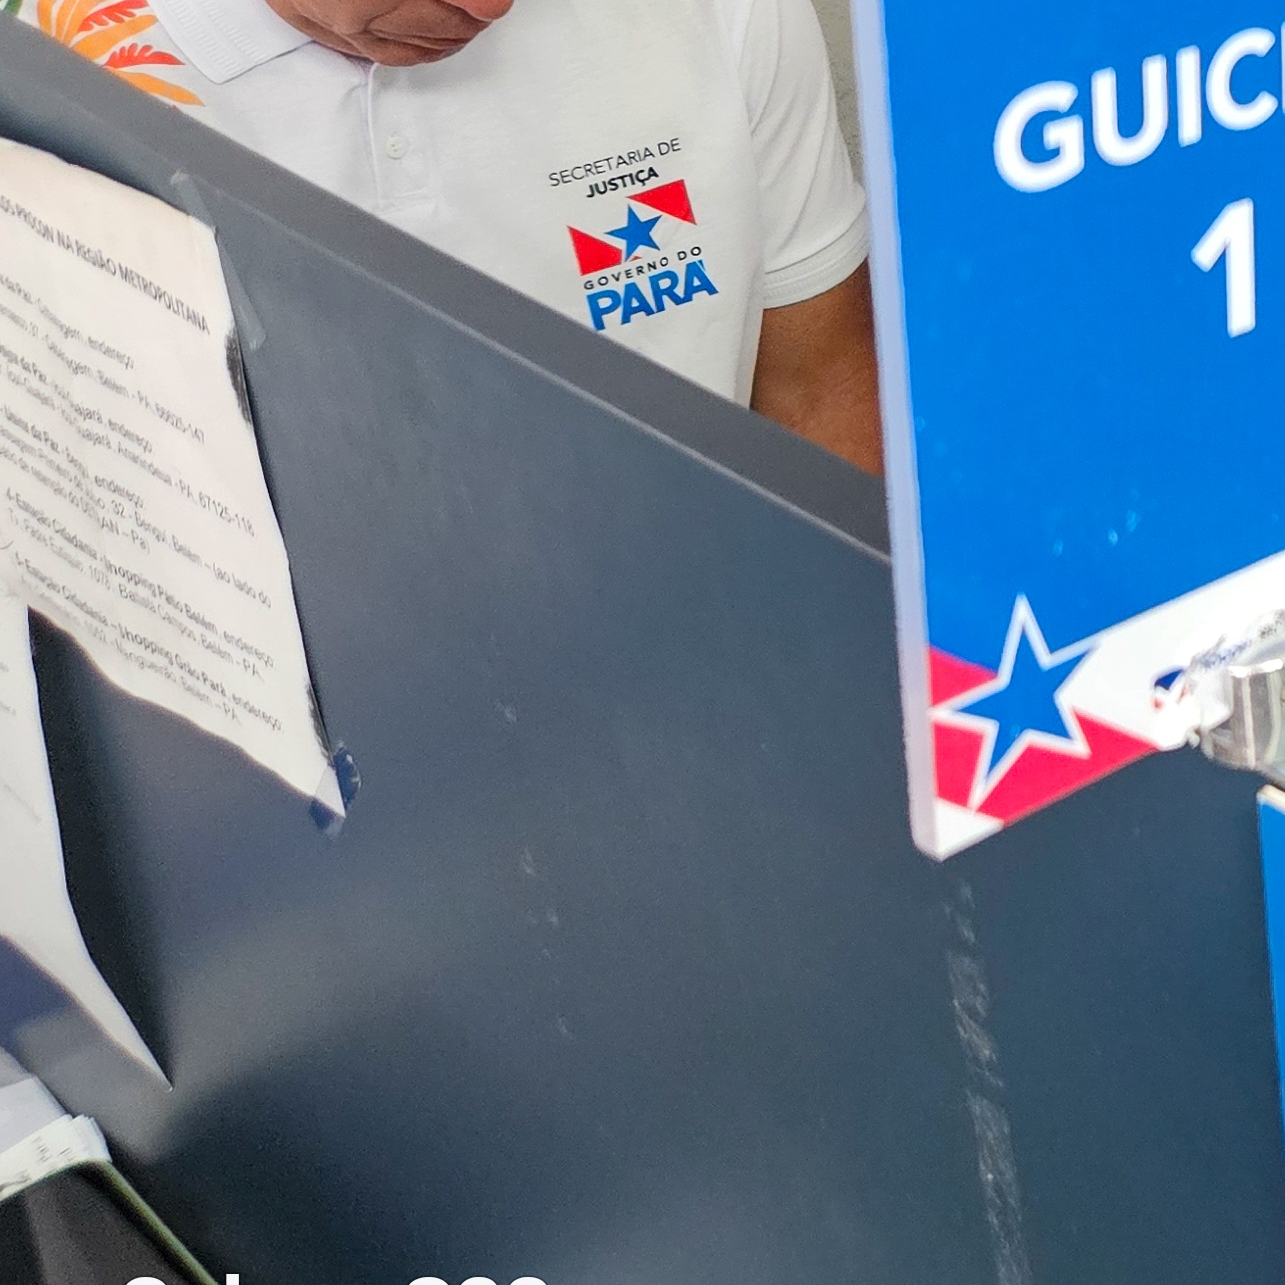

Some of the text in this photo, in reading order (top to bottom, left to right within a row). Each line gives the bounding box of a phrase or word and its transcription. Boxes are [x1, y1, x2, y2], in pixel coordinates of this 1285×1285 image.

[548, 137, 682, 187] SECRETARIA DE
[586, 166, 660, 198] JUSTIÇA
[583, 246, 702, 291] GOVERNO DO
[1191, 197, 1256, 338] 1
